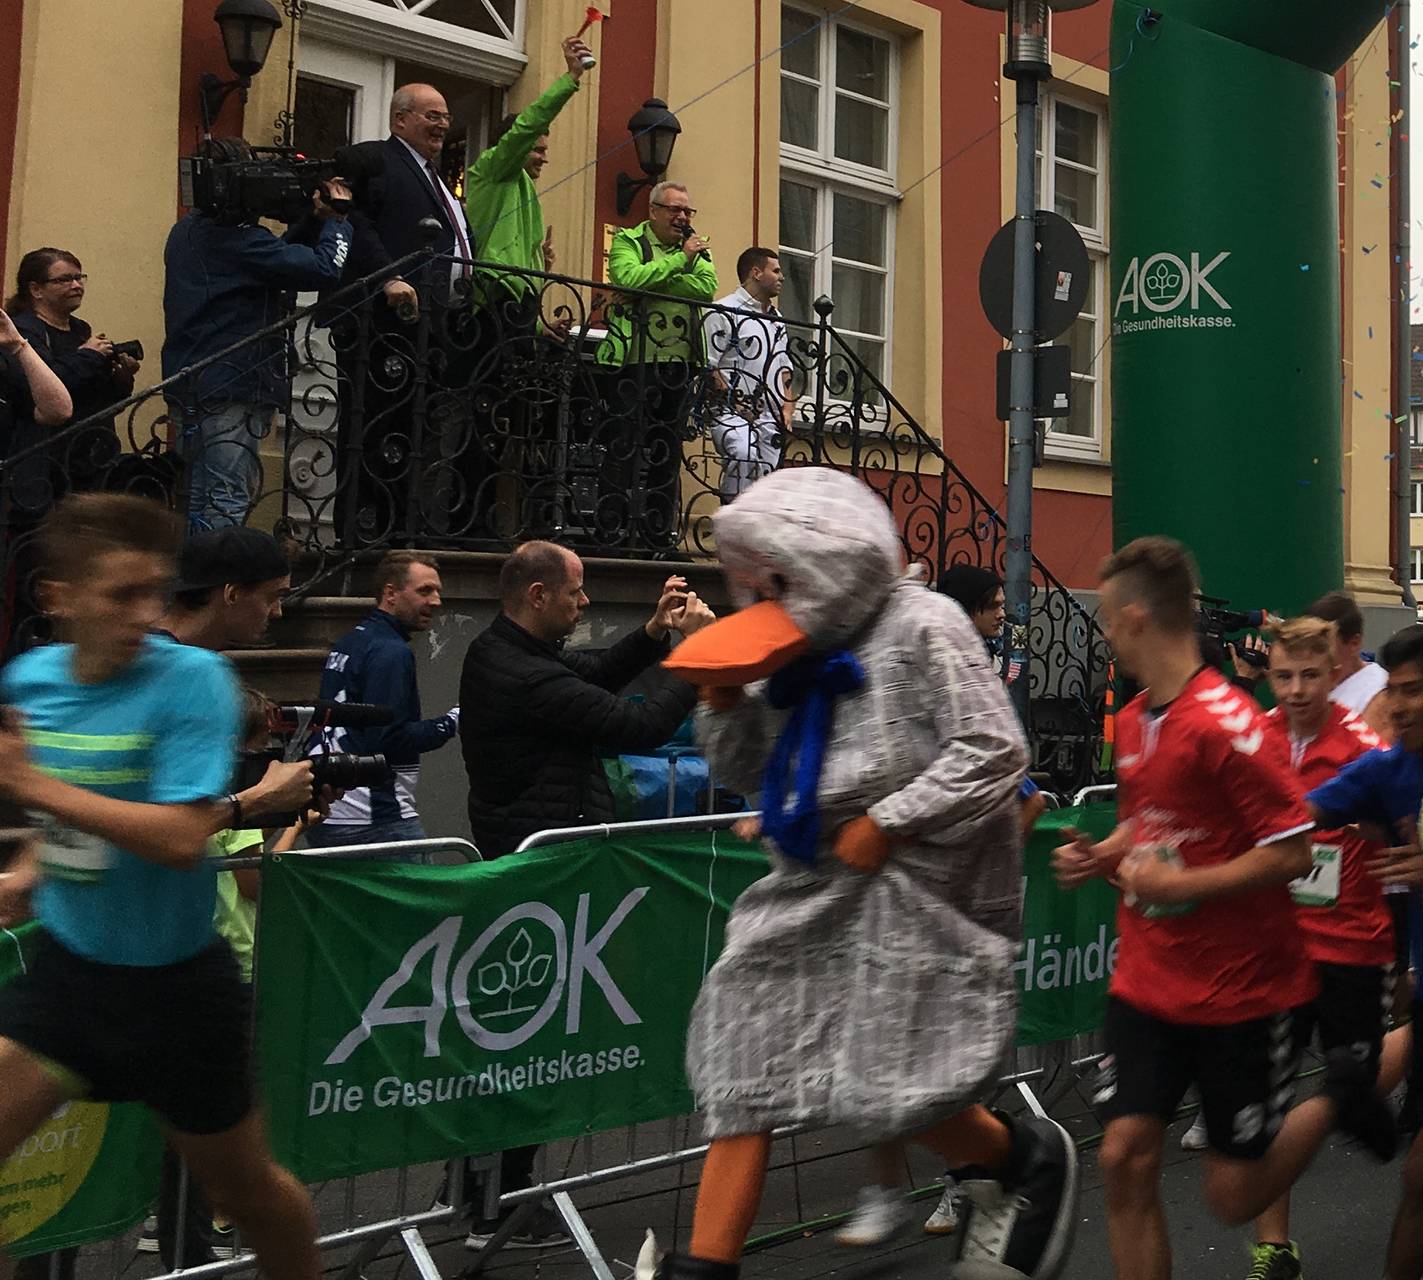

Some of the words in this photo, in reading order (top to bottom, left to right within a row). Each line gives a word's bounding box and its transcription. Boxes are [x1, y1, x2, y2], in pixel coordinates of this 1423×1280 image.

[1114, 252, 1232, 318] AOK
[1122, 315, 1236, 334] Gesundheitskasse.
[323, 887, 651, 1065] AOK
[308, 1079, 363, 1117] Die
[373, 1044, 646, 1108] Gesundheitskasse.
